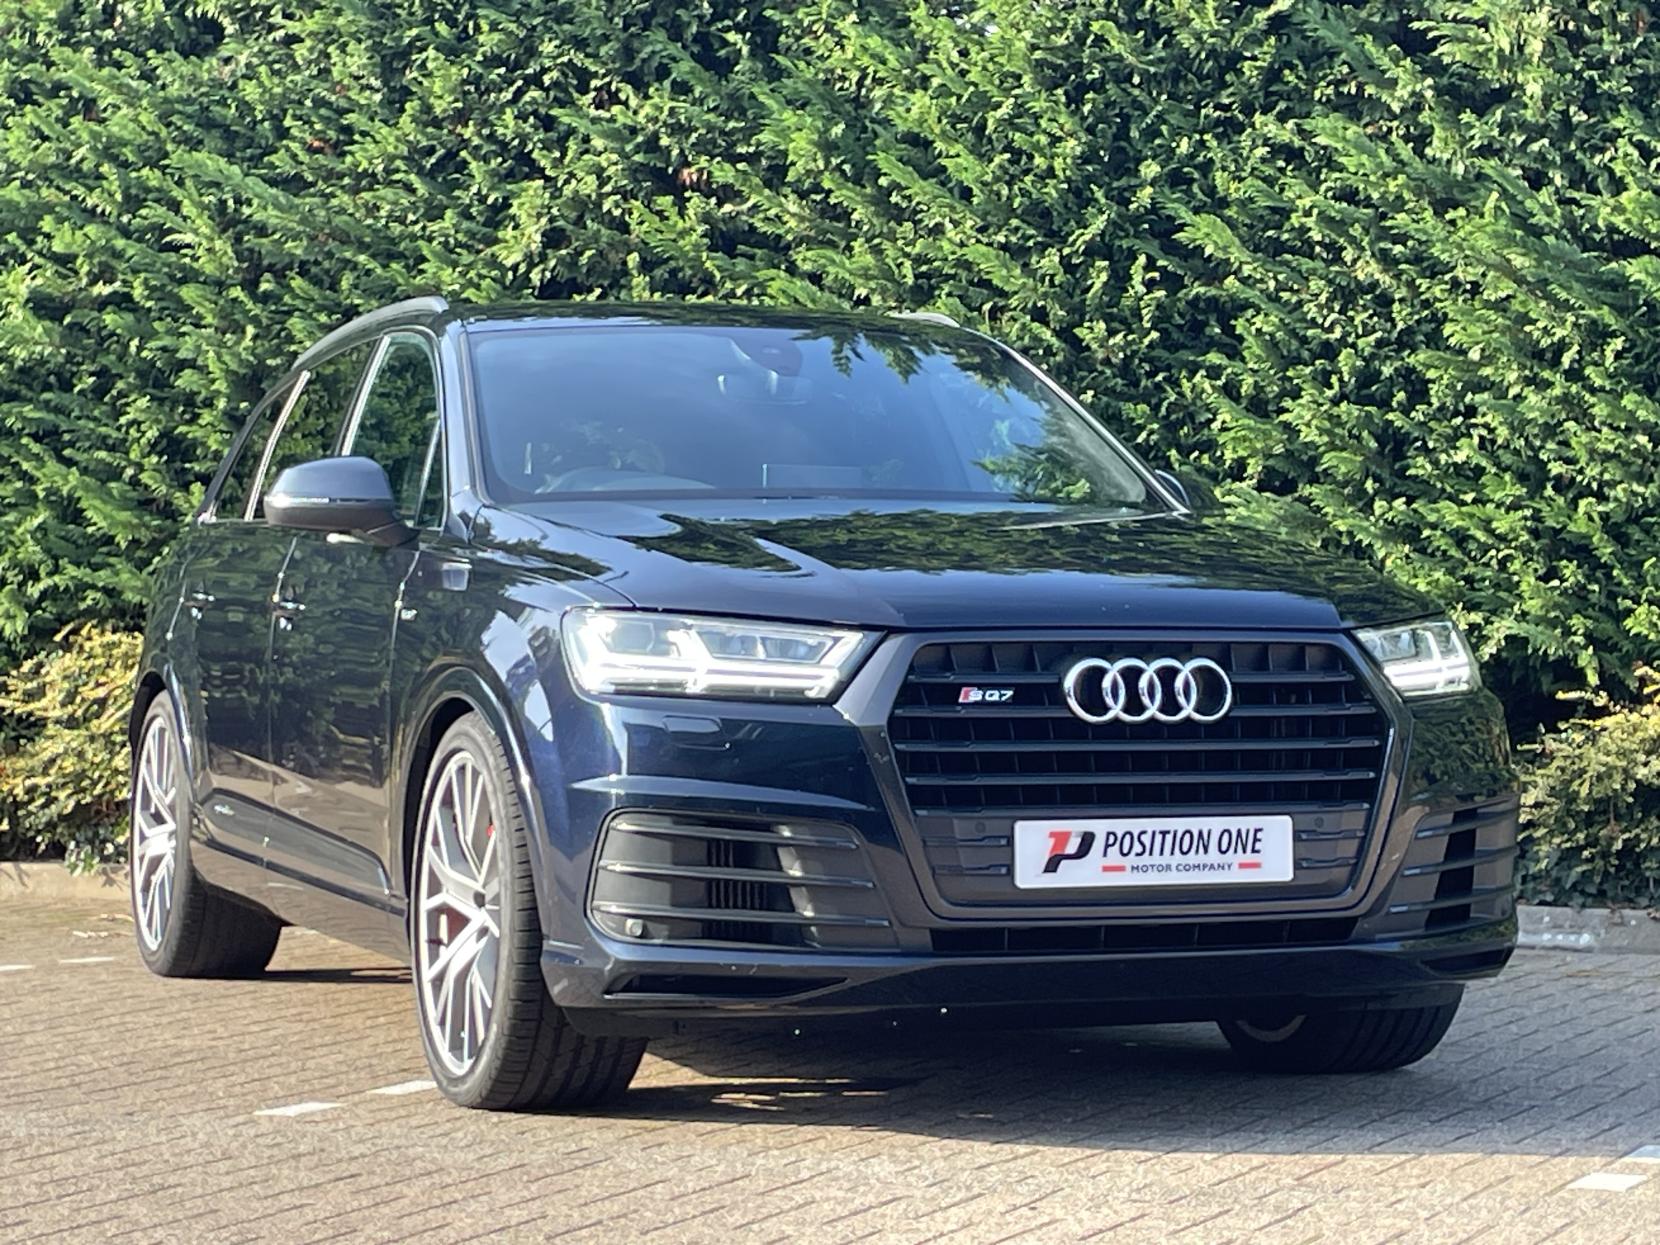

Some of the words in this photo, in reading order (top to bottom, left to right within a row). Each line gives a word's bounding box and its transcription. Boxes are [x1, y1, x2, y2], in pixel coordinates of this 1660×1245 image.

[962, 688, 1014, 702] SQ7
[1103, 829, 1212, 857] POSITION
[1217, 828, 1264, 854] ONE
[1131, 863, 1171, 874] MOTOR
[1175, 862, 1233, 873] COMPANY
